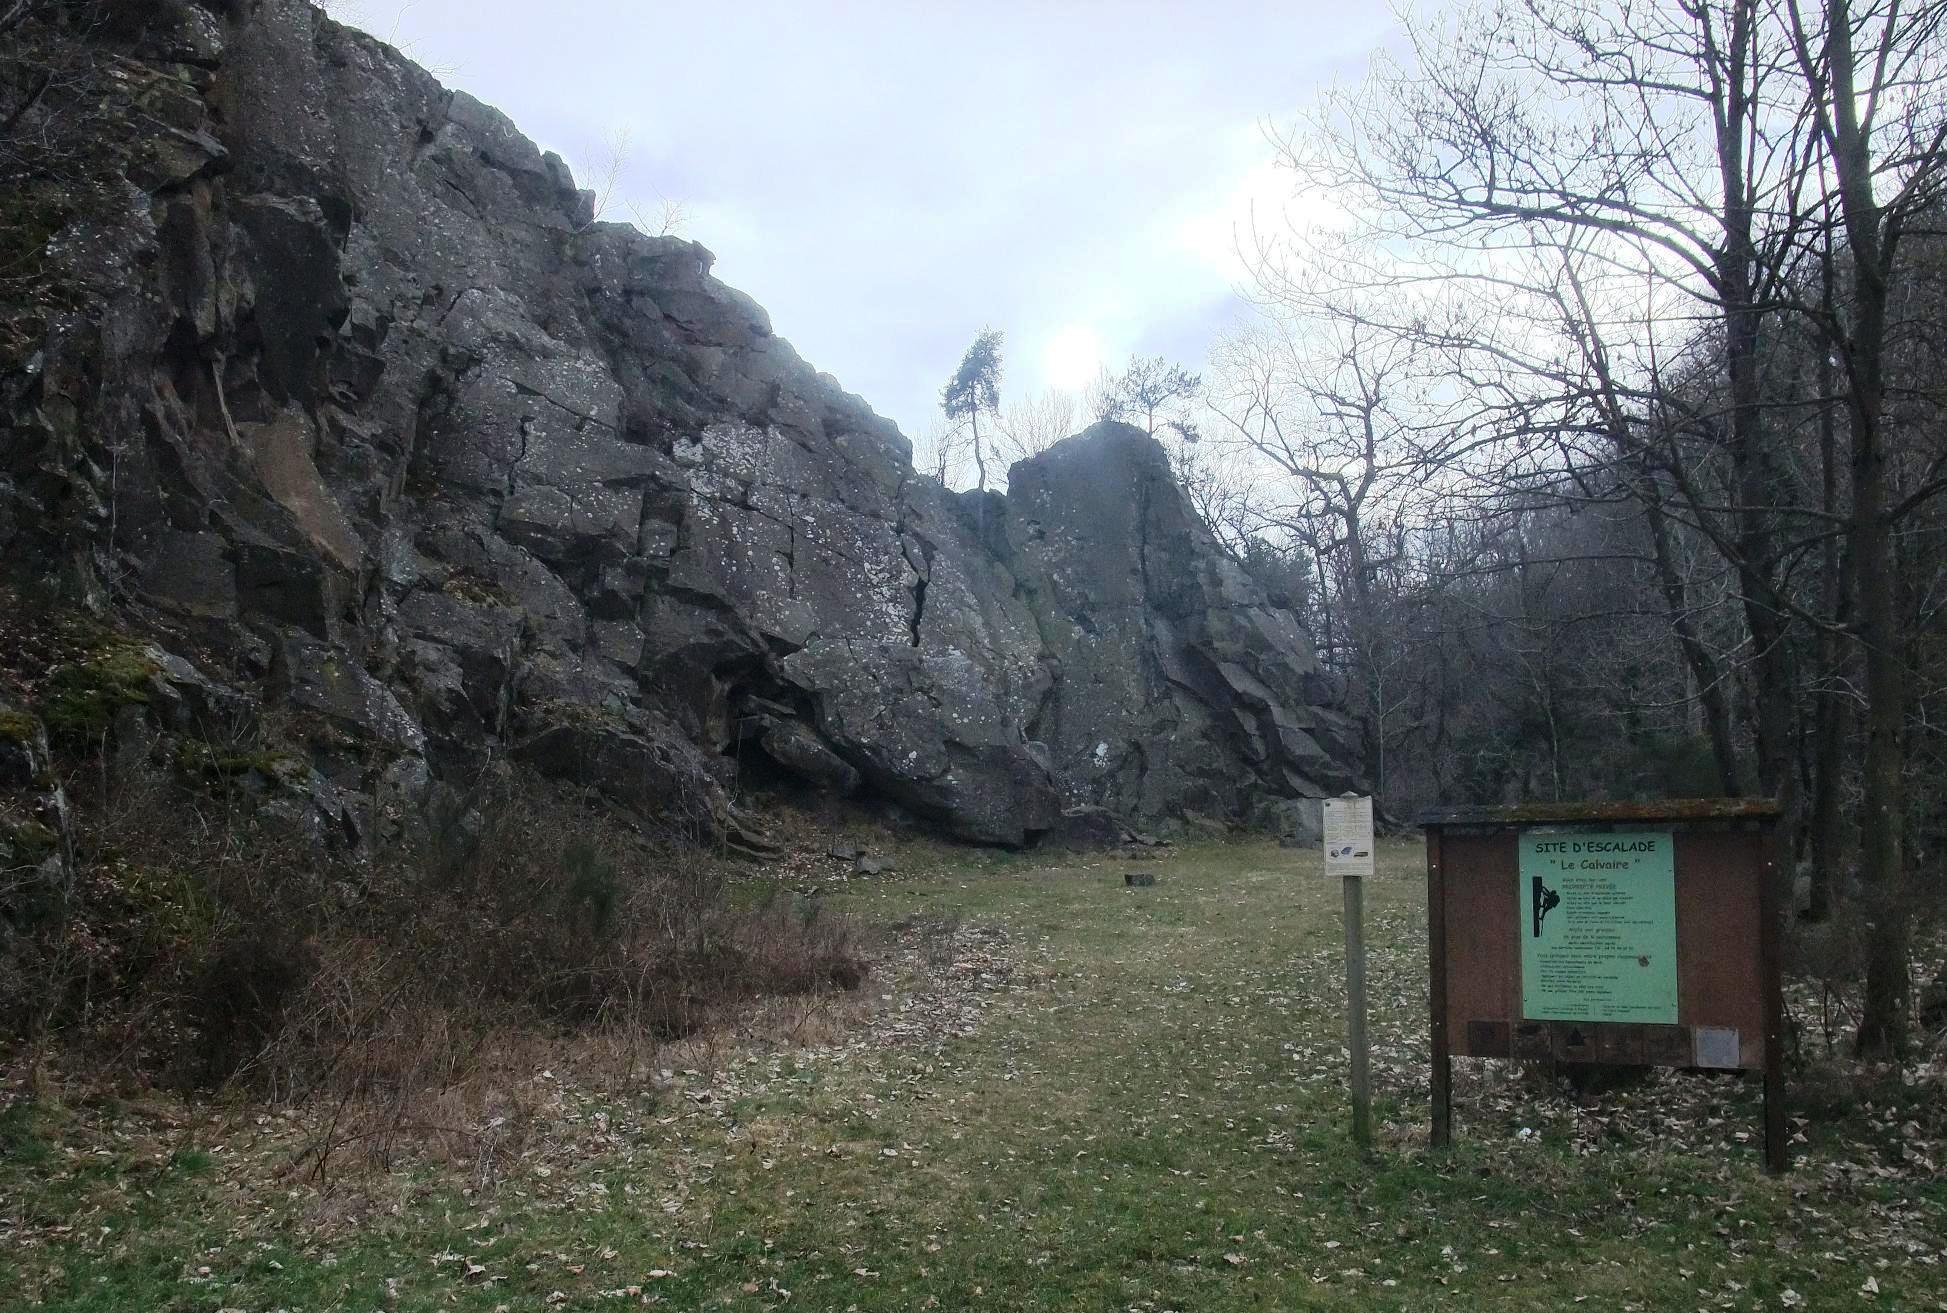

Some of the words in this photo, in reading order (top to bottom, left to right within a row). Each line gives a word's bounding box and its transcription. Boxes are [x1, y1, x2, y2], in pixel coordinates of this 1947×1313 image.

[1536, 841, 1567, 853] SITE
[1573, 840, 1656, 853] D'ESCALADE
[1561, 860, 1575, 870] Le
[1580, 859, 1629, 870] Calvaire
